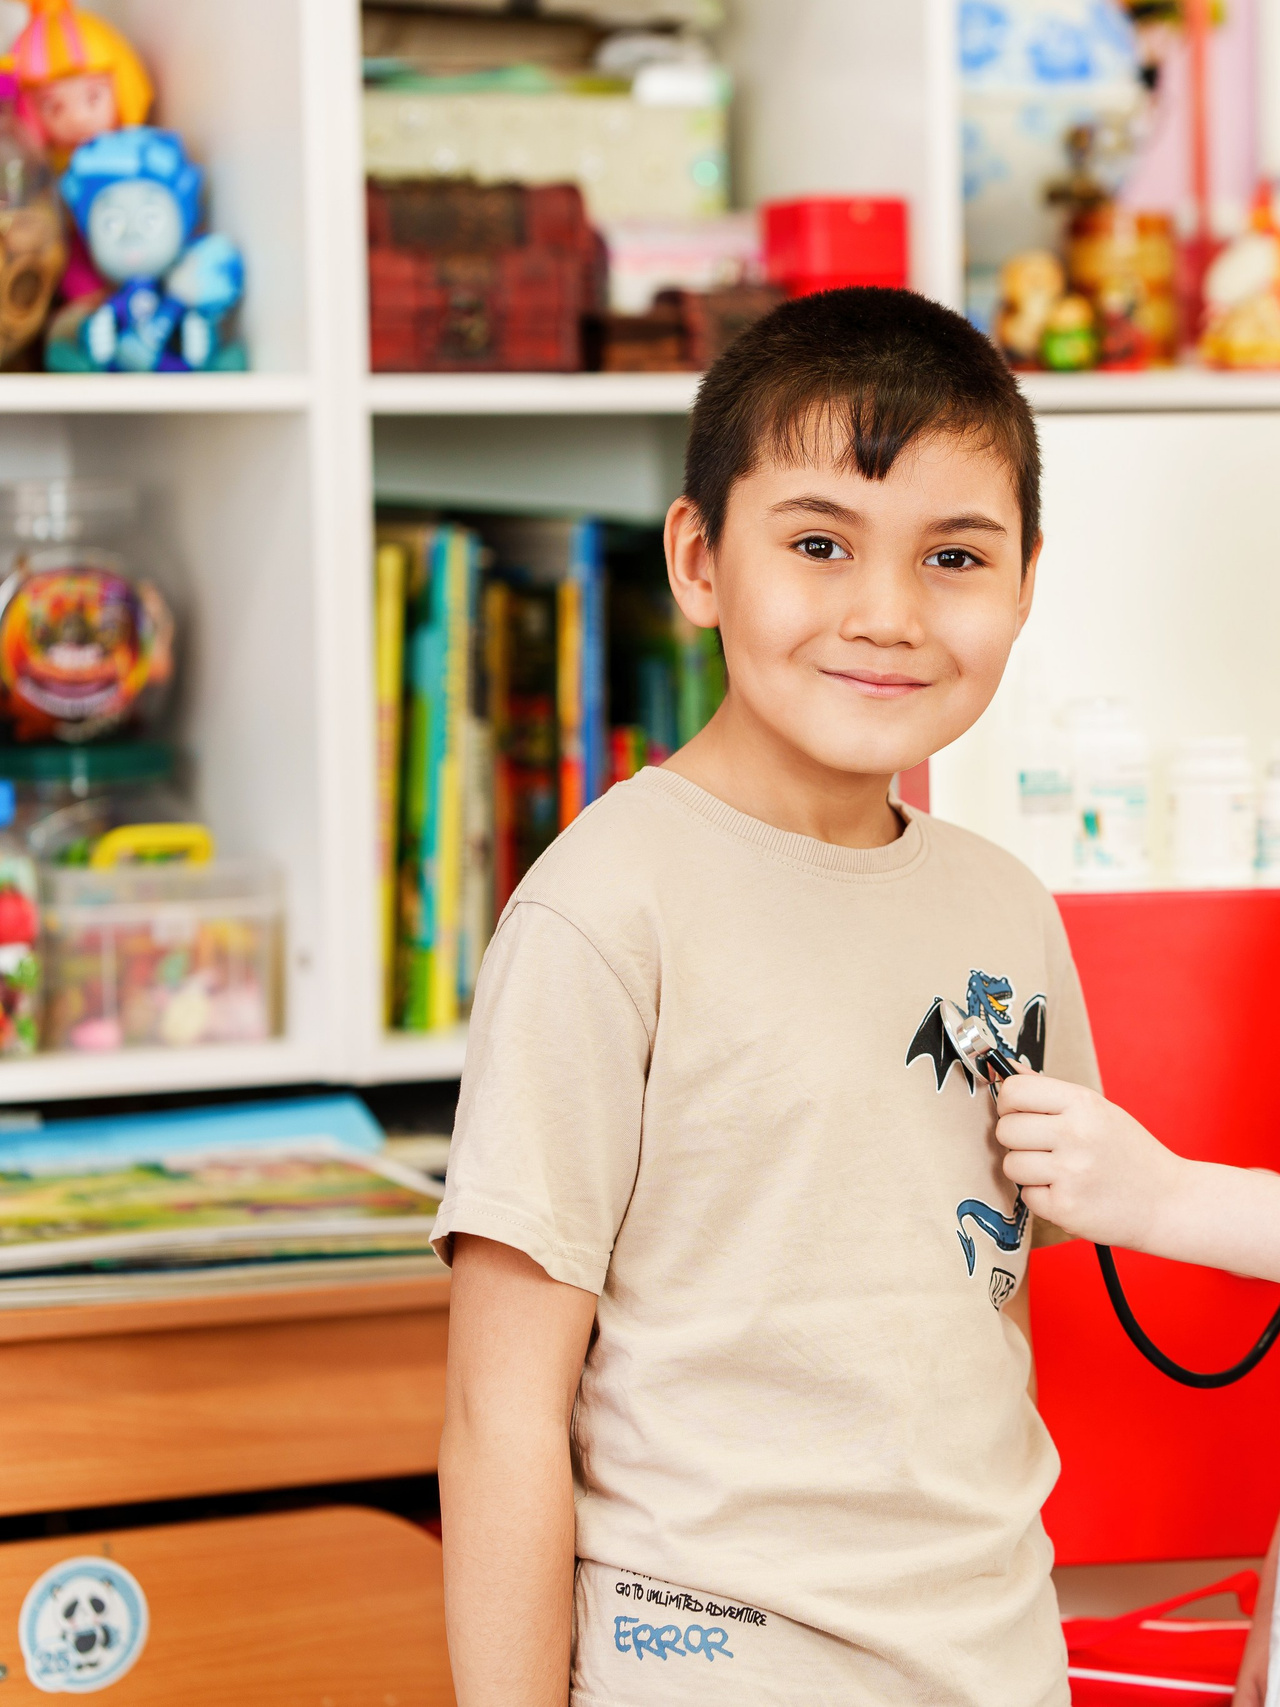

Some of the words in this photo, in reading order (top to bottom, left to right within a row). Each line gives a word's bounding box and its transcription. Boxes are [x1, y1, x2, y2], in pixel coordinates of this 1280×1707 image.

[615, 1582, 630, 1597] GO
[632, 1583, 644, 1600] TO
[705, 1601, 767, 1626] ADVENTURE
[614, 1616, 734, 1661] ERROR
